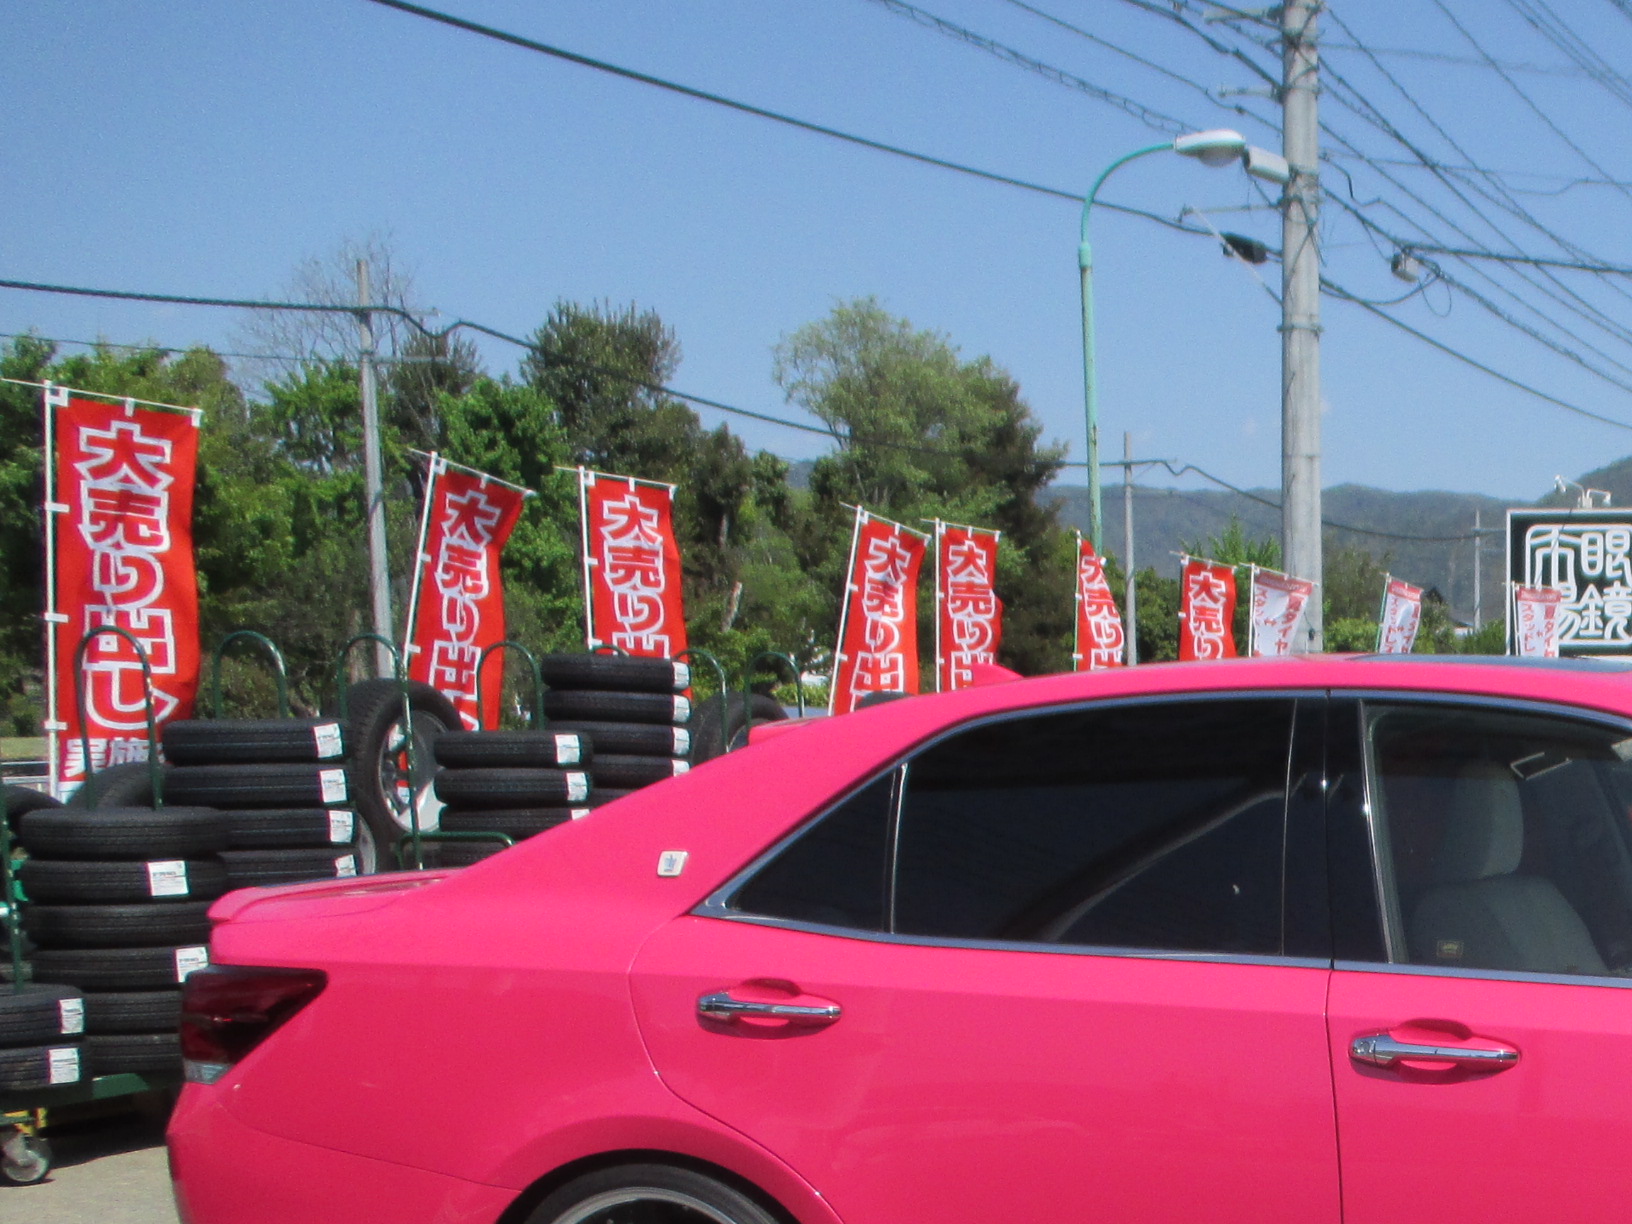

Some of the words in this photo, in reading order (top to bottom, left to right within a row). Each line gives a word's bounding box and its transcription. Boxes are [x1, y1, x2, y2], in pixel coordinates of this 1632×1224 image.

[73, 420, 179, 731] 大売り出し
